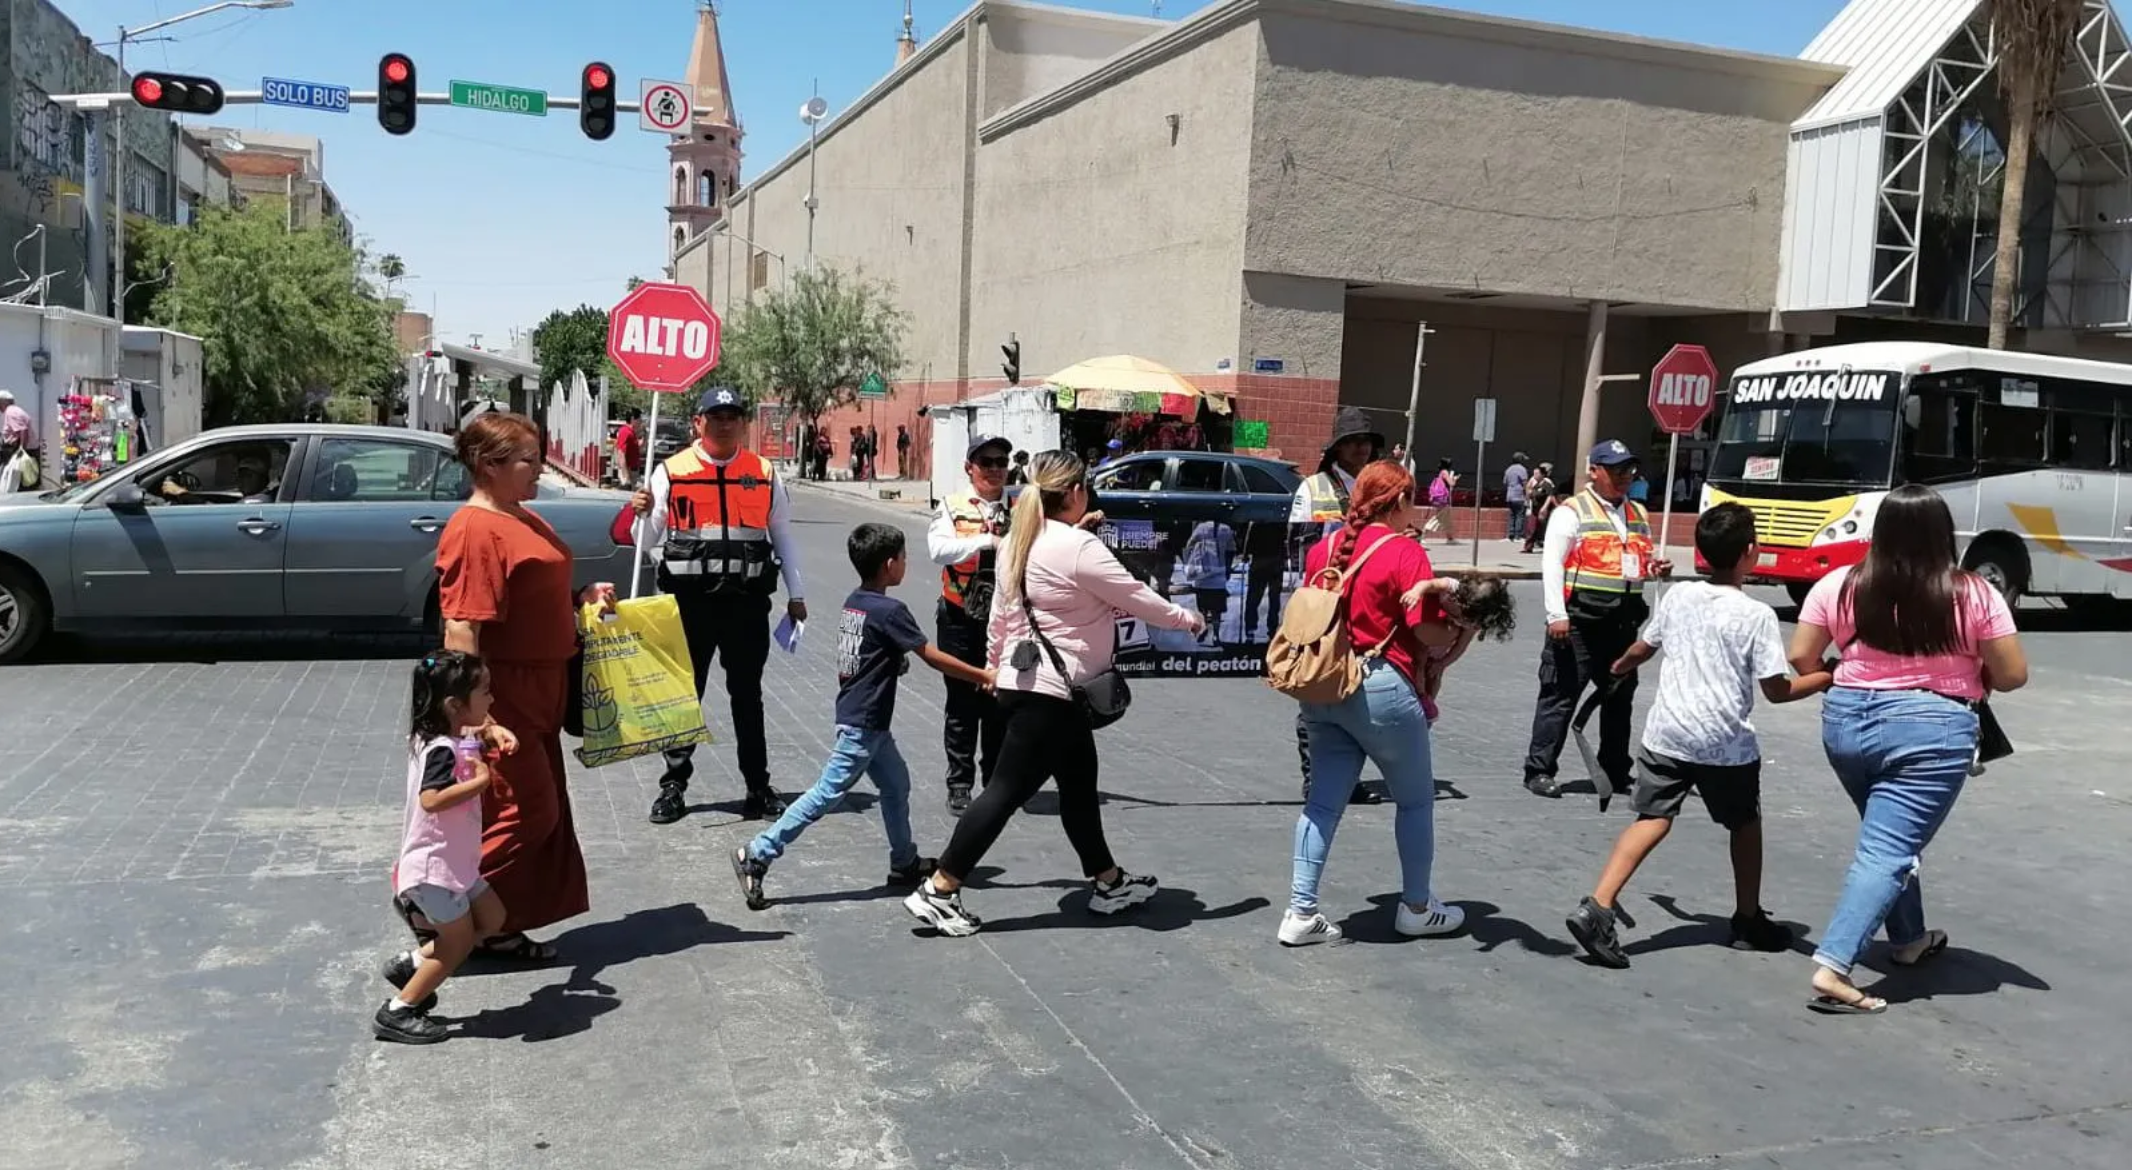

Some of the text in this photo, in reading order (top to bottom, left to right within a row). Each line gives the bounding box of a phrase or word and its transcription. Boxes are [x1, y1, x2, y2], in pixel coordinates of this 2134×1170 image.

[266, 82, 347, 109] SOLO BUS
[467, 89, 529, 112] HIDALGO
[620, 314, 708, 360] ALTO
[1657, 373, 1710, 407] ALTO
[1734, 371, 1887, 404] SAN JOAQUIN
[1162, 655, 1192, 671] del
[1196, 654, 1262, 675] peatón
